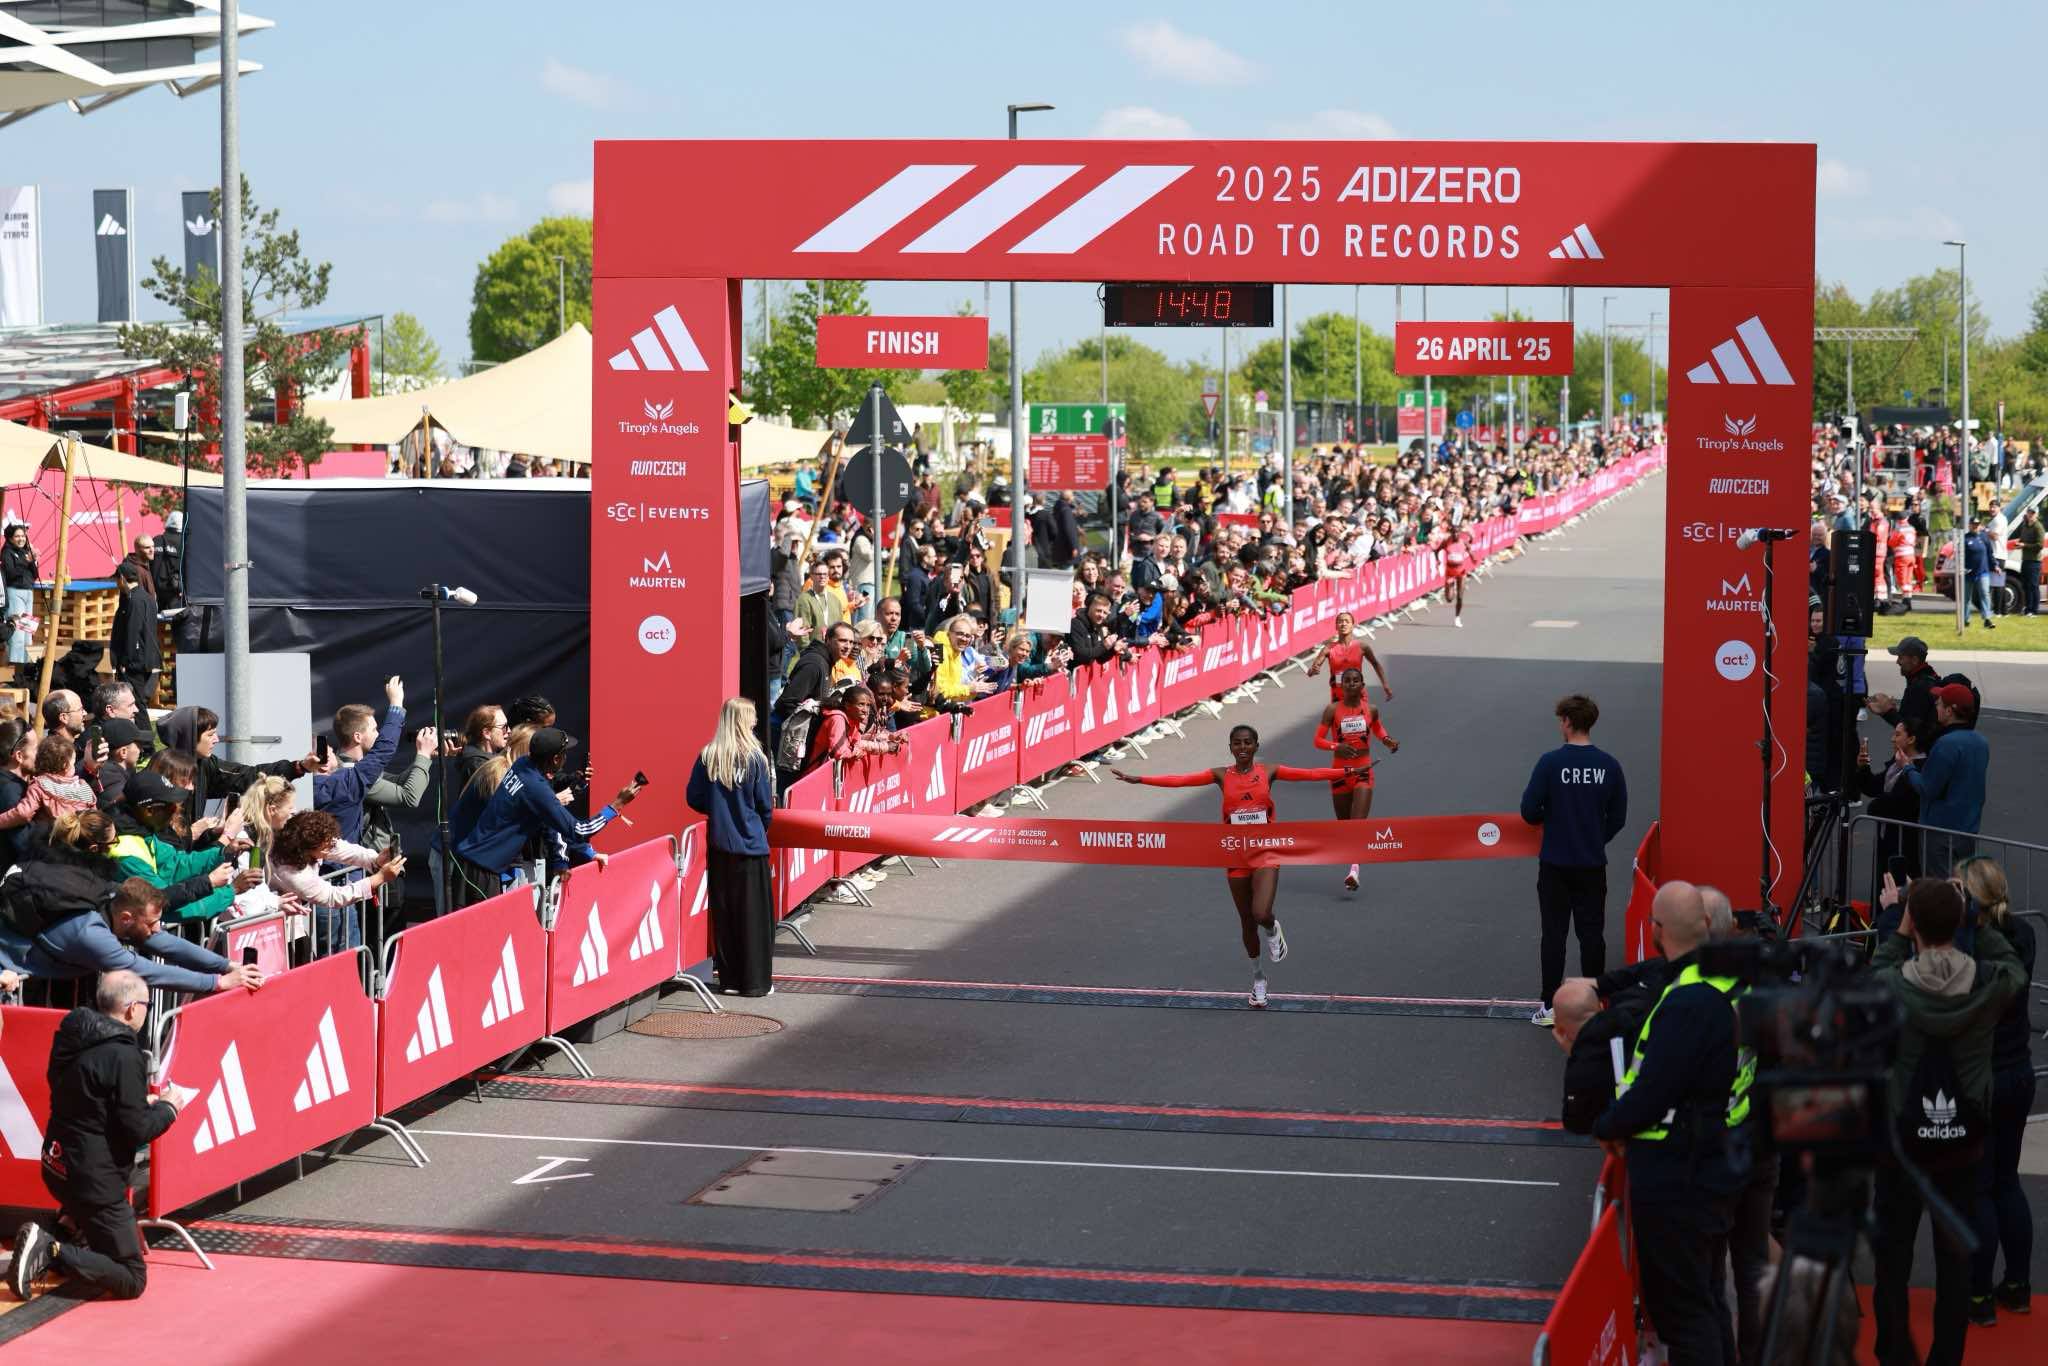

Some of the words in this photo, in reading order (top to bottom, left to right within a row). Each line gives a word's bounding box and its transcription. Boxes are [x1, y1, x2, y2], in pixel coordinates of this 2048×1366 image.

[1216, 165, 1322, 202] 2025
[1337, 166, 1522, 204] ADIZERO
[1158, 222, 1255, 257] ROAD
[1277, 223, 1320, 258] TO
[1344, 223, 1521, 259] RECORDS
[1157, 290, 1232, 319] 14:48
[866, 330, 940, 356] FINISH
[1416, 336, 1445, 361] 26
[1448, 336, 1512, 362] APRIL
[618, 421, 658, 436] Tirop's
[660, 422, 700, 436] Angels
[1696, 437, 1739, 452] Tirop's
[1742, 438, 1784, 452] Angels
[607, 502, 637, 522] SCC
[648, 507, 710, 520] EVENTS
[1683, 522, 1715, 542] SCC
[629, 577, 687, 588] MAURTEN
[502, 769, 524, 796] REW
[1560, 767, 1607, 785] CREW
[1079, 831, 1133, 849] WINNER
[1136, 832, 1166, 849] 5KM
[1220, 836, 1241, 851] SCC
[1249, 837, 1295, 848] EVENTS
[1367, 842, 1403, 851] MAURTEN
[1917, 1125, 1967, 1139] adidas
